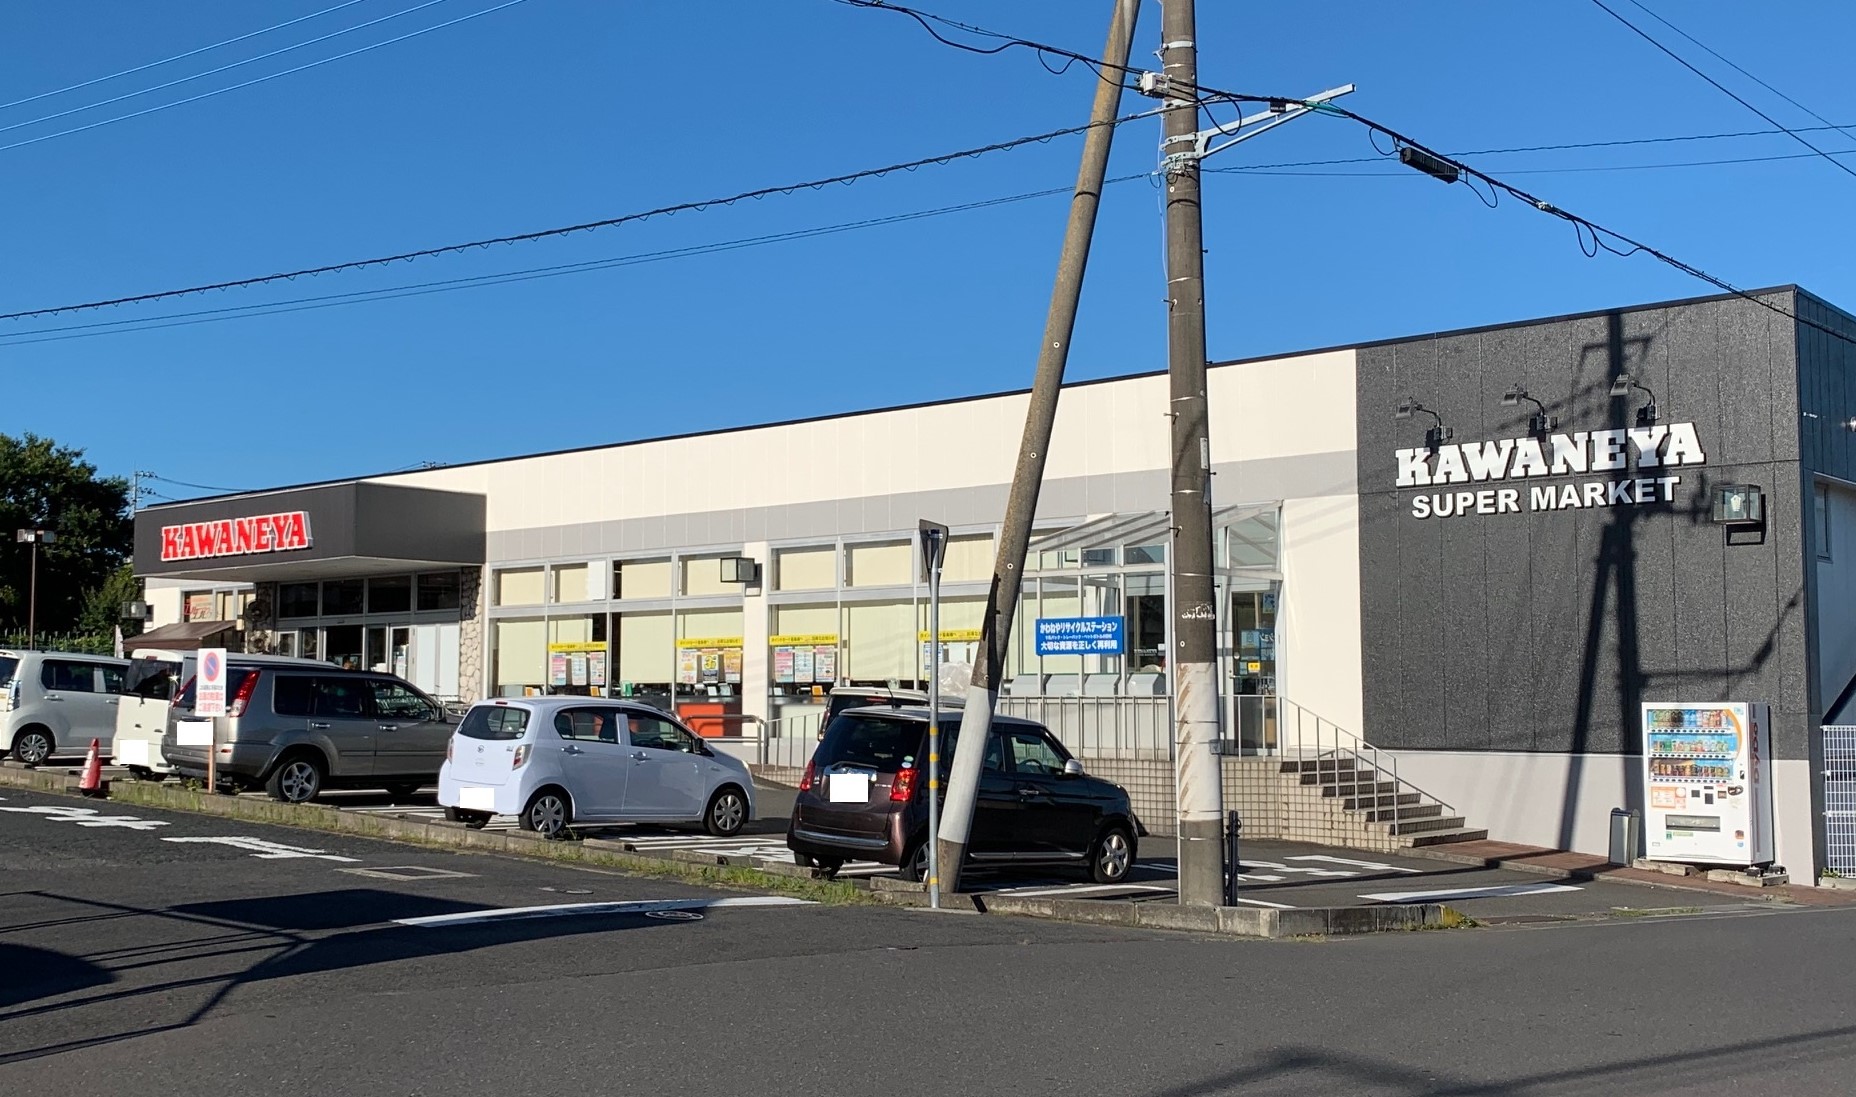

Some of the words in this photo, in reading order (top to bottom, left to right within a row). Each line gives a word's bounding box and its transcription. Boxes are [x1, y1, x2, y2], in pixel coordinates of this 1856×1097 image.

[1395, 422, 1706, 488] KAWANEYA
[1411, 488, 1521, 518] SUPER
[1531, 476, 1681, 511] MARKET
[161, 511, 309, 561] KAWANEYA
[1040, 622, 1118, 633] かわねやリサイクルステーション
